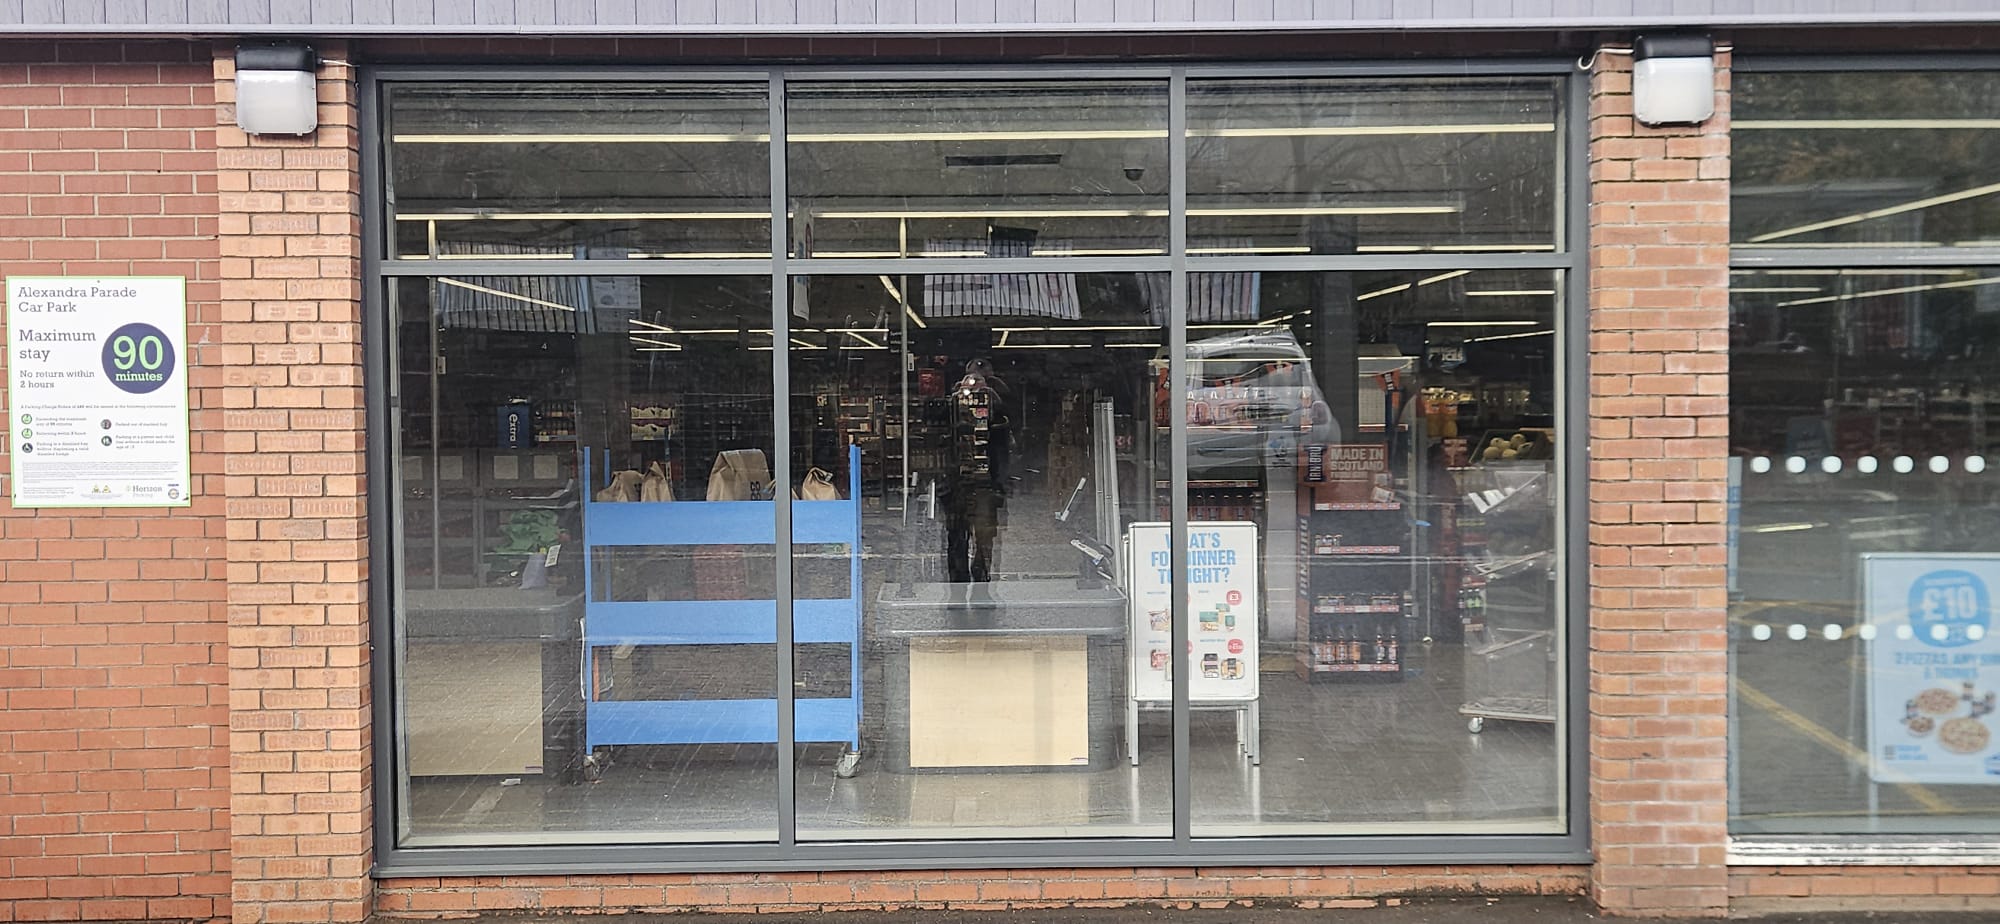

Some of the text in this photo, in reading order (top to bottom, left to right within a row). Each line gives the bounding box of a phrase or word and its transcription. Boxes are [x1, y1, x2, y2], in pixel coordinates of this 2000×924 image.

[17, 286, 137, 298] Alexandra Parade
[18, 301, 77, 313] Car Park
[19, 329, 96, 342] Maximum
[19, 348, 51, 363] stay
[113, 335, 163, 370] 90
[20, 369, 95, 378] No return within
[115, 371, 163, 382] minutes
[20, 380, 55, 388] 2 hours
[508, 413, 518, 442] extra
[1330, 448, 1384, 460] MADE IN
[1330, 461, 1384, 471] SCOTLAND
[1187, 549, 1237, 566] INNER
[1920, 585, 1978, 620] £10
